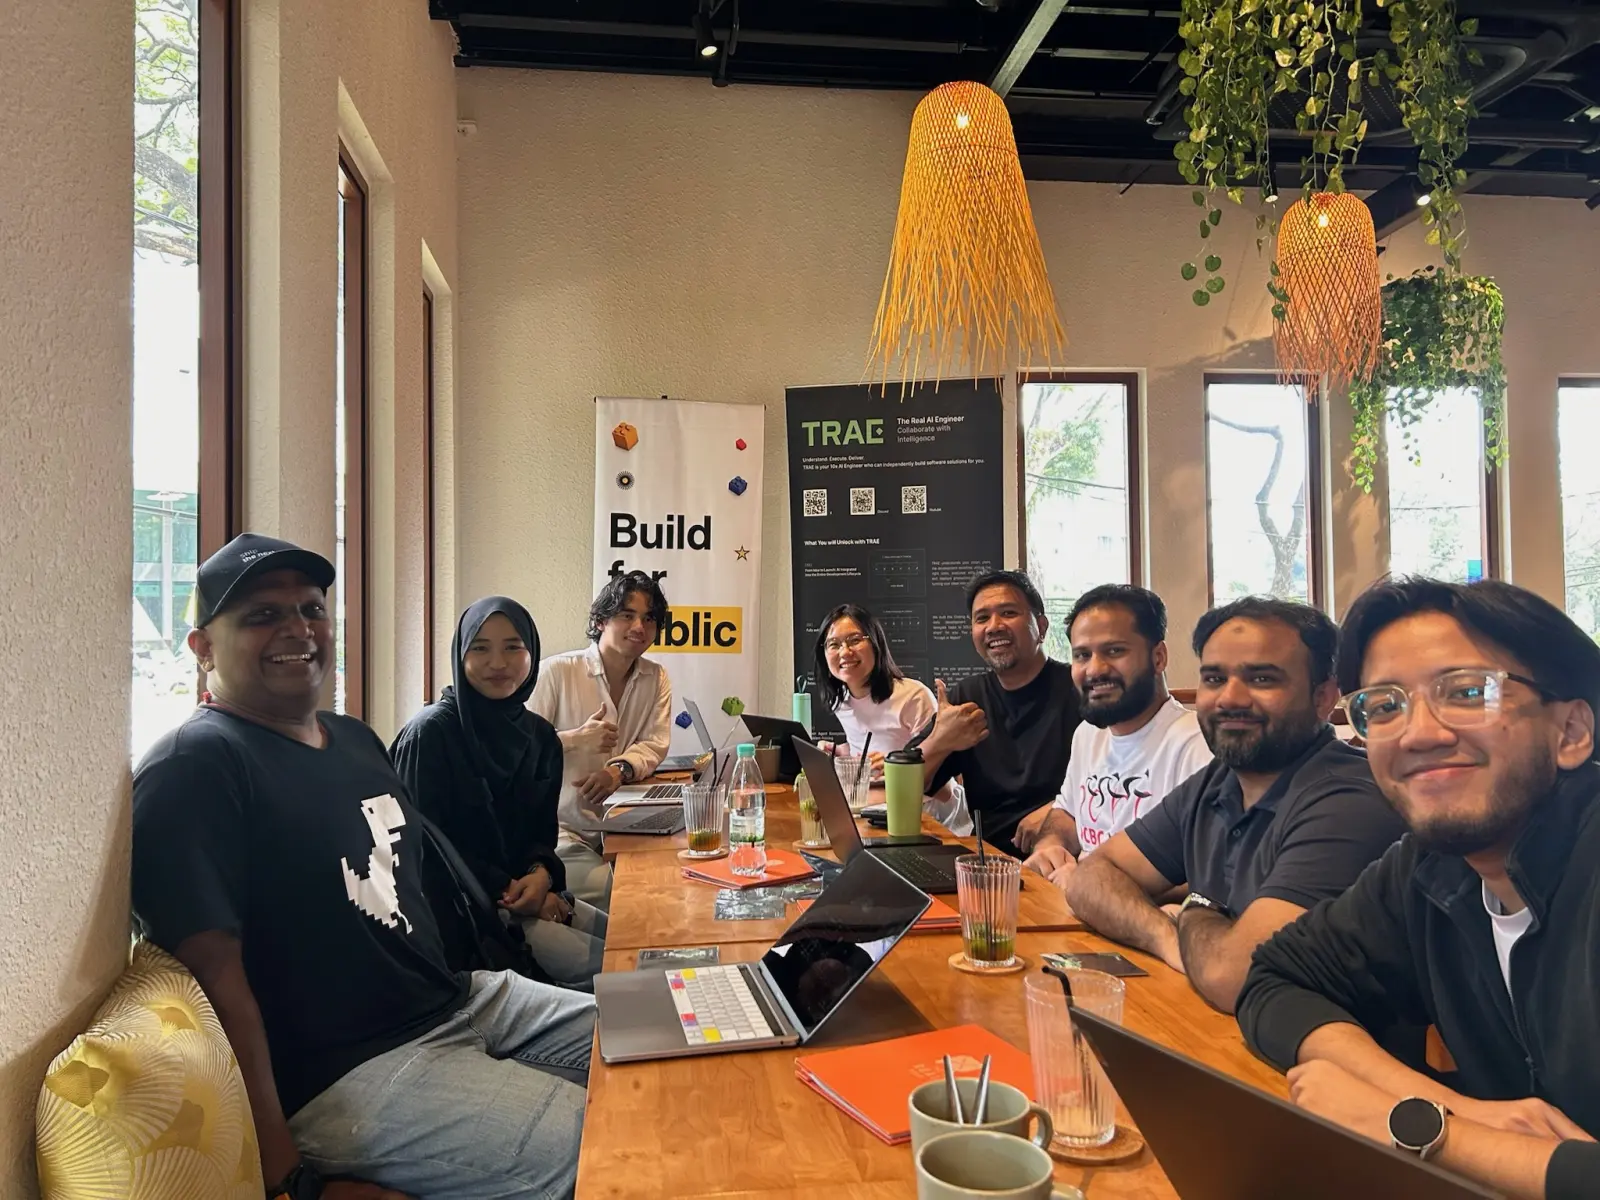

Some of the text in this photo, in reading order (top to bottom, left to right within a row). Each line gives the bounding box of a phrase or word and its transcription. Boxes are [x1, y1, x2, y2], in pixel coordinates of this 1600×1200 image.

[897, 417, 910, 425] The
[935, 415, 965, 424] Engineer
[897, 424, 951, 434] Collaborate with
[802, 419, 884, 447] TRAE
[897, 434, 936, 444] Intelligence
[610, 513, 712, 551] Build
[653, 611, 737, 647] blic
[1081, 827, 1104, 845] CBC
